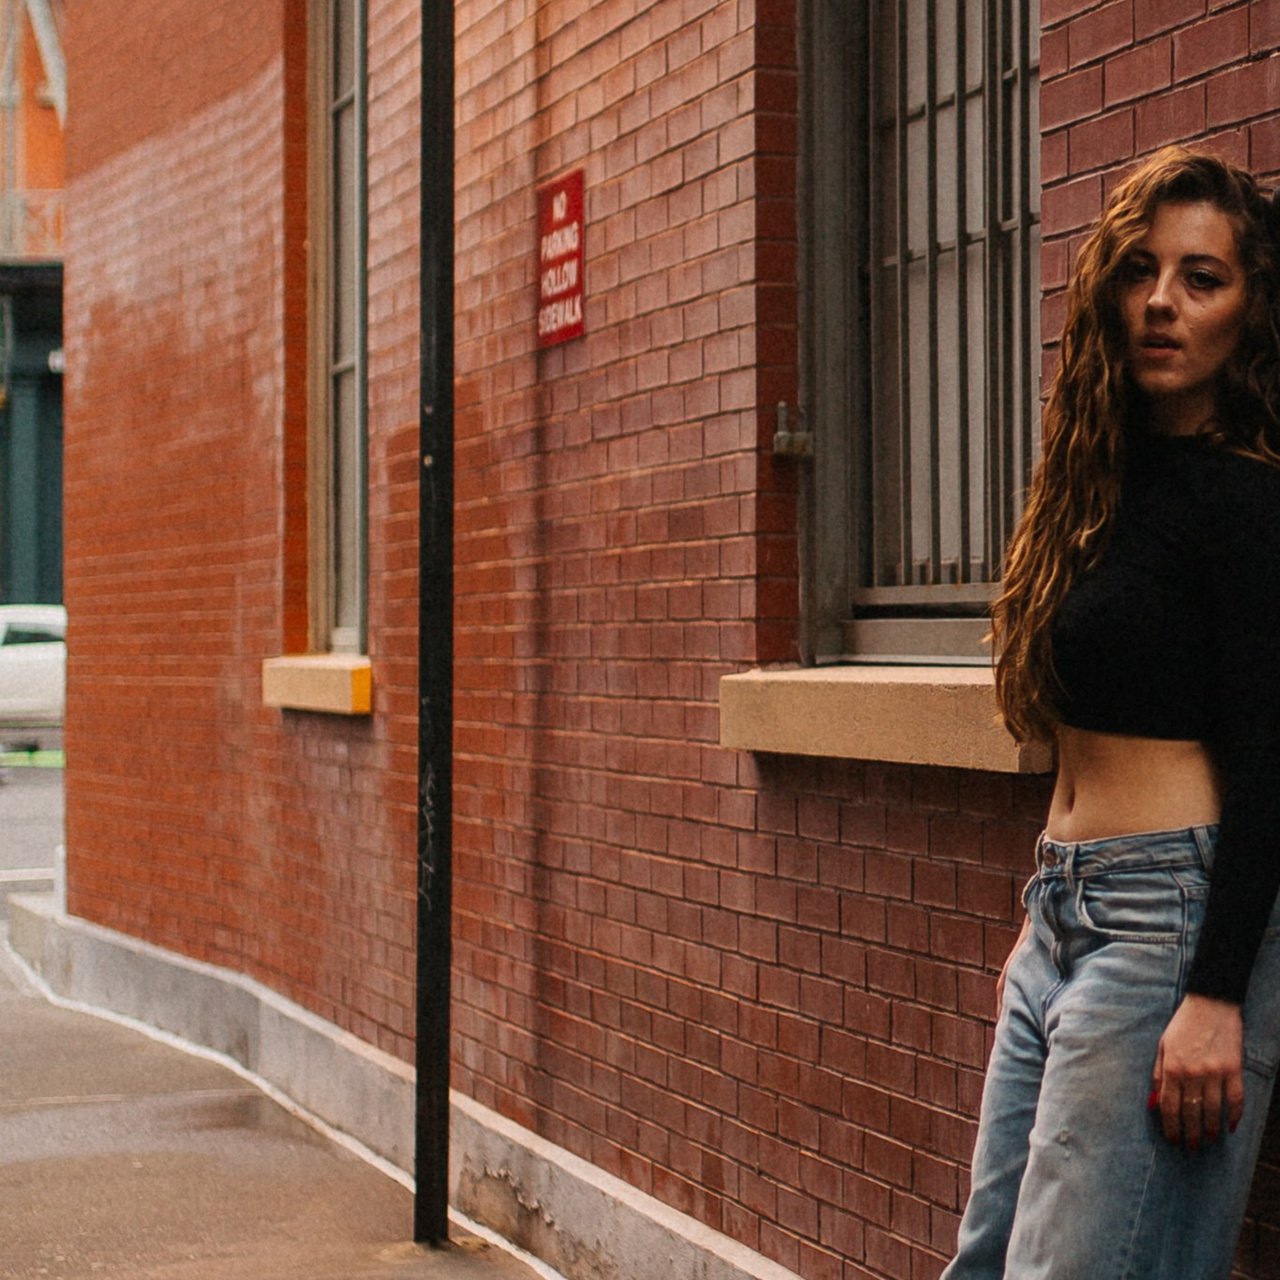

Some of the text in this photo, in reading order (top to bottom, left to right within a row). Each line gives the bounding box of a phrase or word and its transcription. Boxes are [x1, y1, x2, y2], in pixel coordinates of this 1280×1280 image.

[552, 189, 567, 221] NO
[540, 220, 579, 264] PARKING
[540, 257, 579, 299] HOLLOW
[538, 293, 582, 337] SIDEWALK
